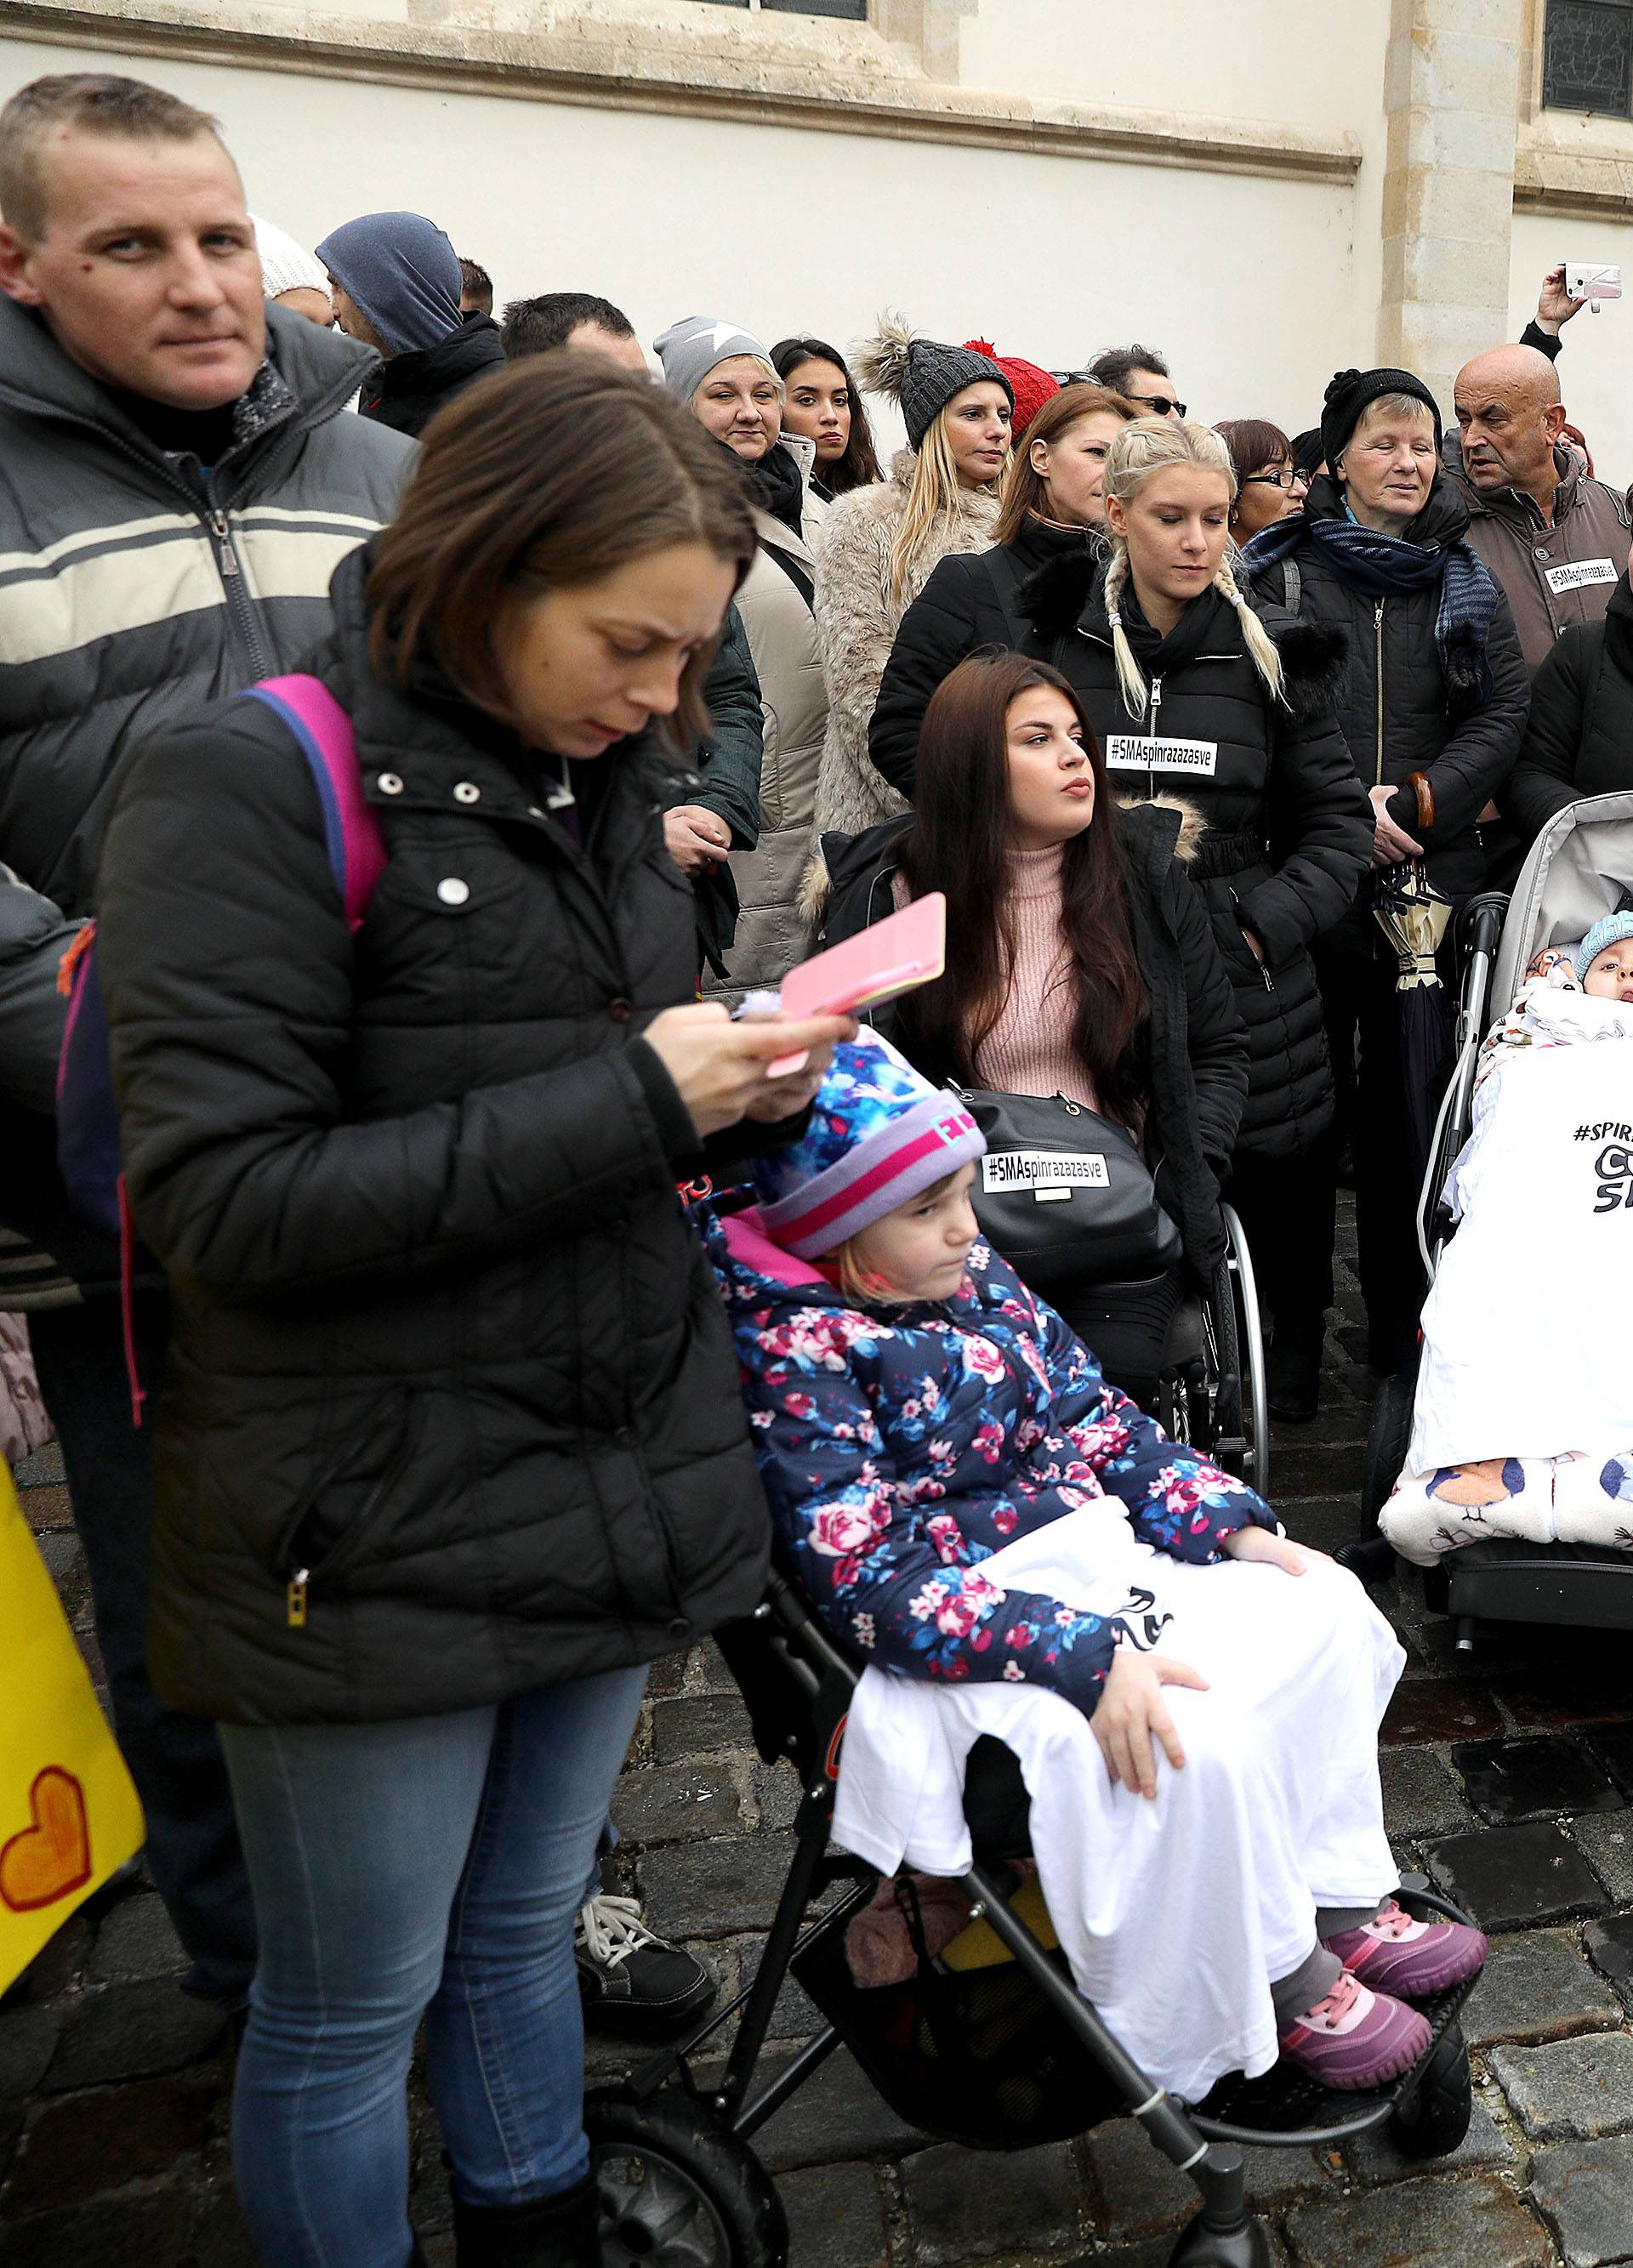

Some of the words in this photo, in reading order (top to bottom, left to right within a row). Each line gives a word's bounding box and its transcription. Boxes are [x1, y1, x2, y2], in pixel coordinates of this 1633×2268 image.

[1111, 738, 1211, 769] #SMAspinrazazasve
[1573, 1122, 1633, 1142] #SPIR
[989, 1156, 1101, 1186] #SMAspinrazazasve
